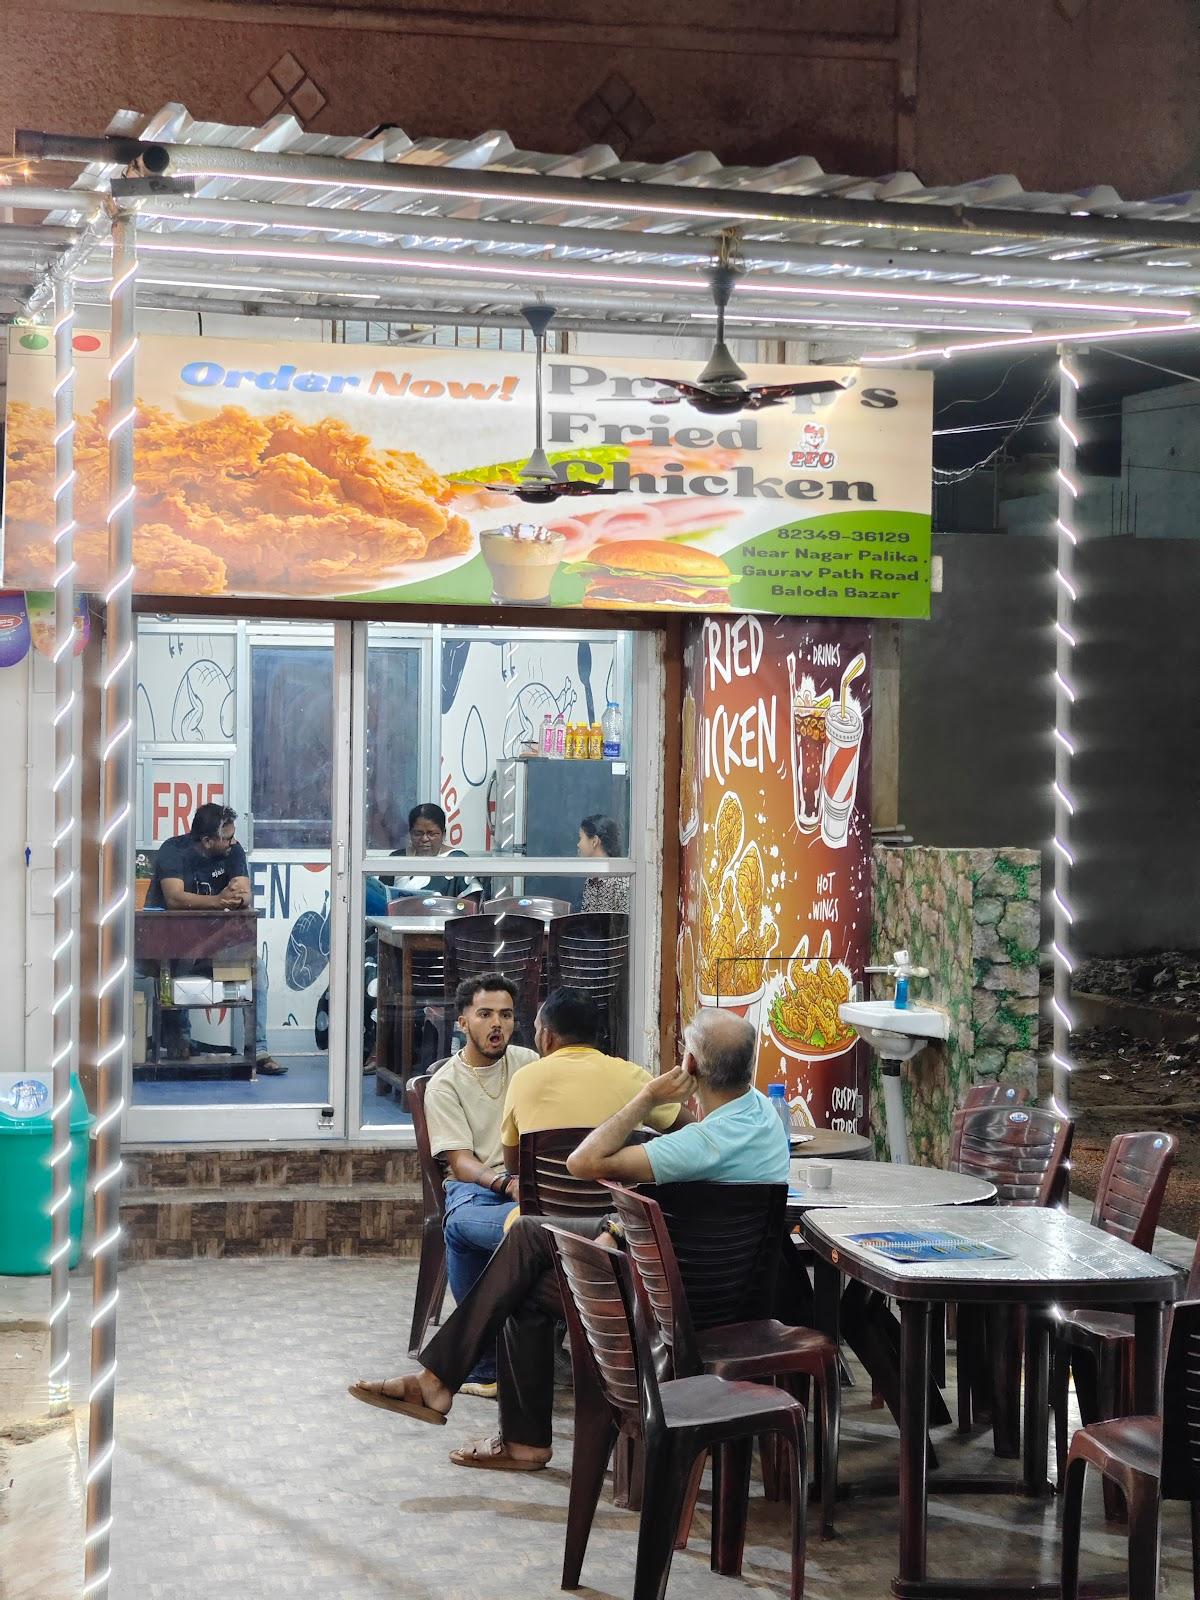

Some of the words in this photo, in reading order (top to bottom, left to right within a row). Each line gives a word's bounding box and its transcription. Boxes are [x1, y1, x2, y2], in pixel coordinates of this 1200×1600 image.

[180, 361, 361, 393] Order
[368, 370, 520, 401] Now!
[547, 411, 762, 451] Fried
[551, 459, 877, 502] Chicken
[777, 528, 910, 543] 82349-36129
[742, 546, 789, 559] Near
[795, 548, 852, 562] Nagar
[858, 550, 918, 564] Palika
[742, 565, 812, 578] Gaurav
[818, 567, 864, 580] Path
[870, 569, 919, 581] Road
[771, 585, 839, 598] Baloda
[844, 587, 901, 600] Bazar
[812, 642, 841, 668] DRINKS
[702, 695, 777, 786] ICKEN
[816, 871, 836, 895] HOT
[812, 898, 839, 923] WINGS
[831, 1086, 858, 1112] CRISPY
